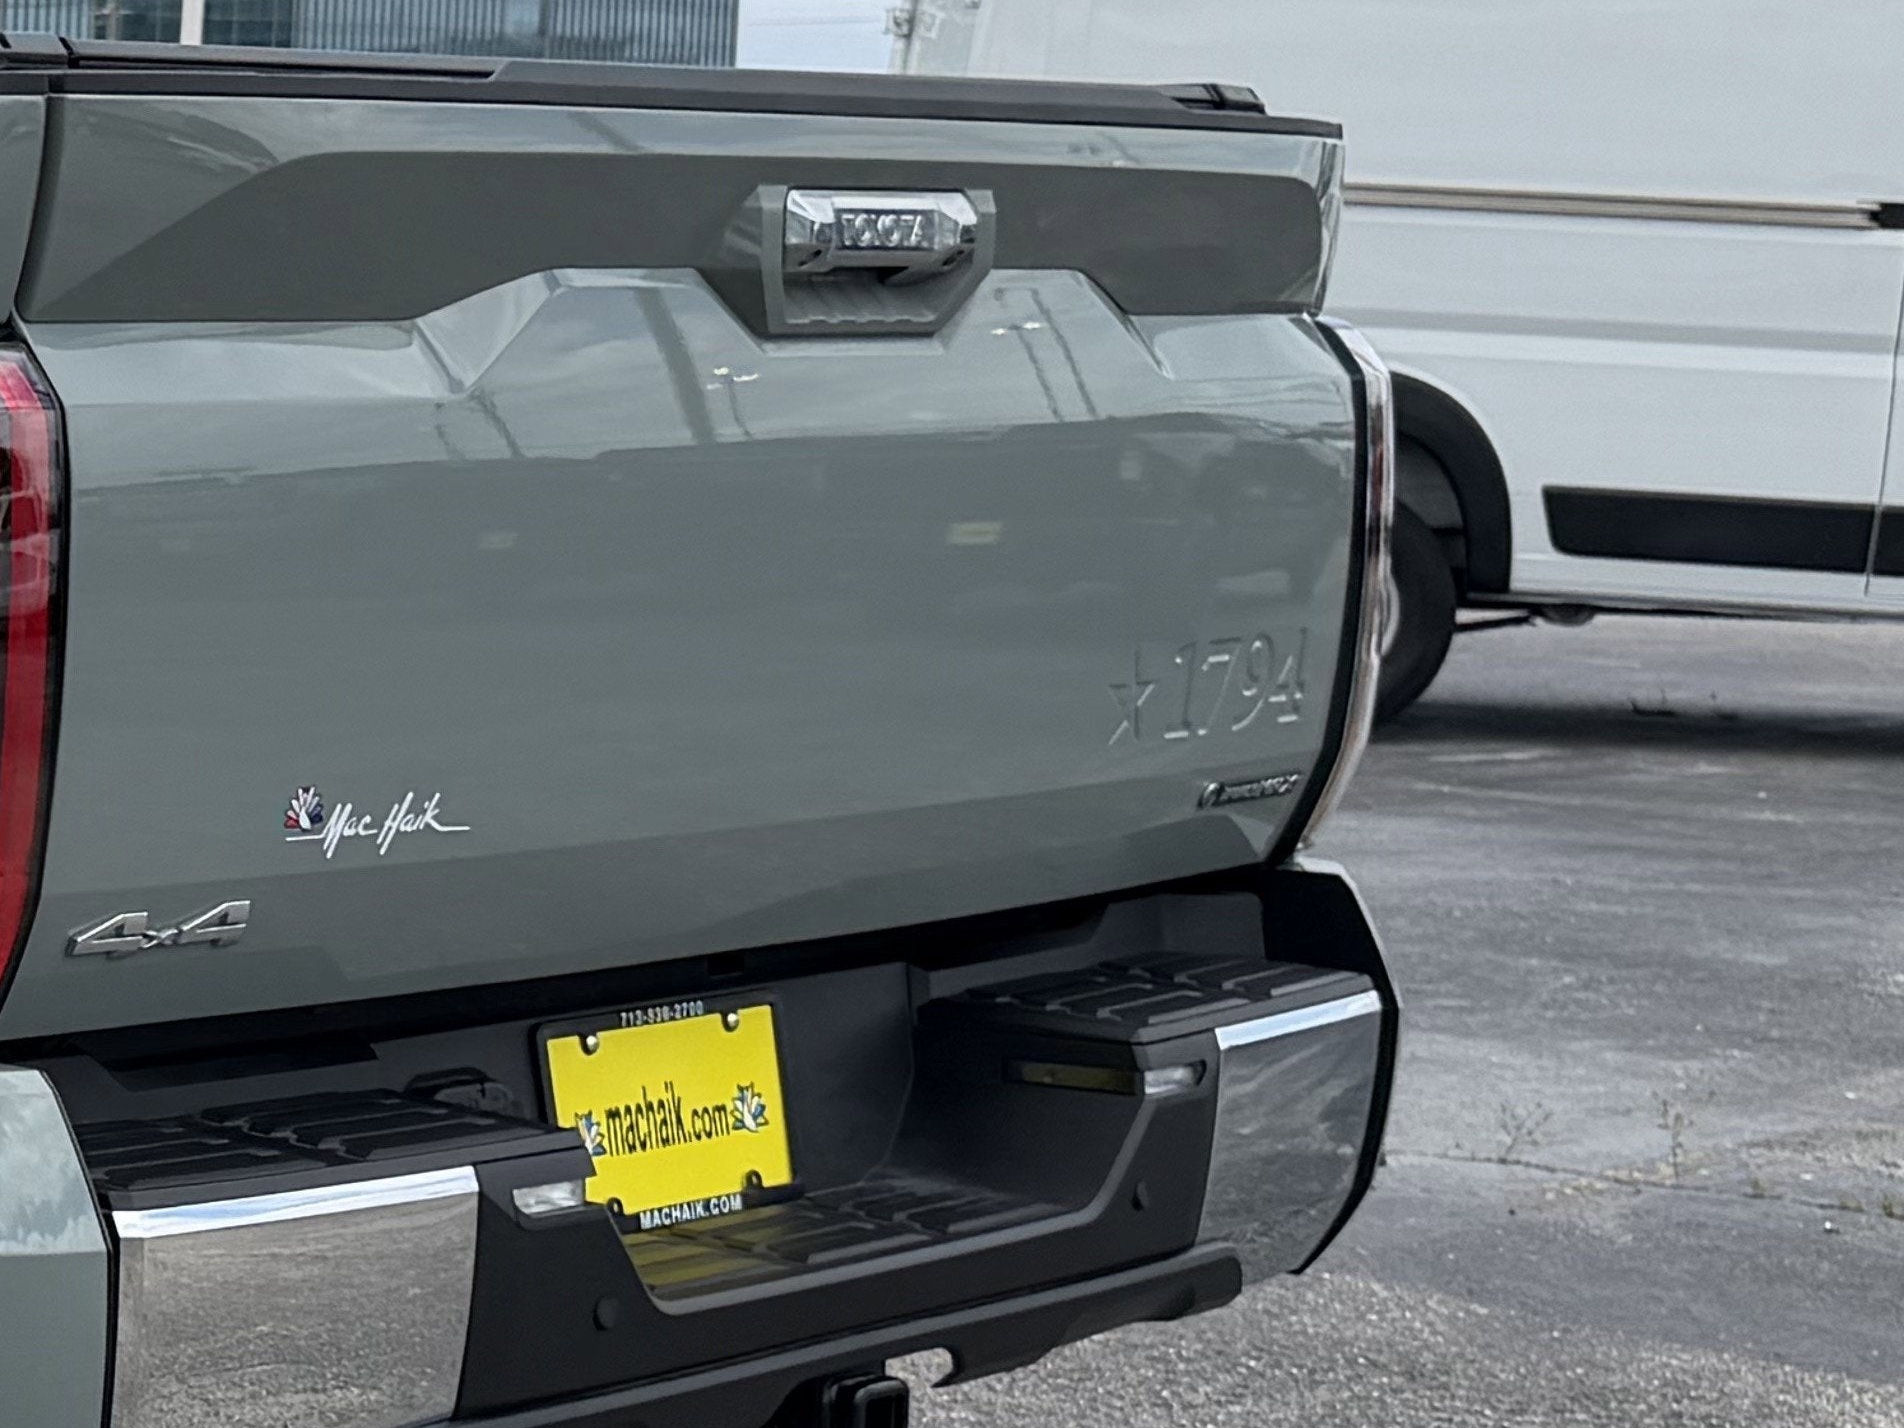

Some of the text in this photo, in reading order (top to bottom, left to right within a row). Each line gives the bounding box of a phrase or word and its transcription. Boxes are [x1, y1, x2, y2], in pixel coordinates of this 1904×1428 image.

[286, 791, 471, 860] Mac Haik
[64, 898, 252, 959] 4x4
[604, 1081, 732, 1158] machaik.com
[639, 1193, 744, 1230] MACHAIK.COM
